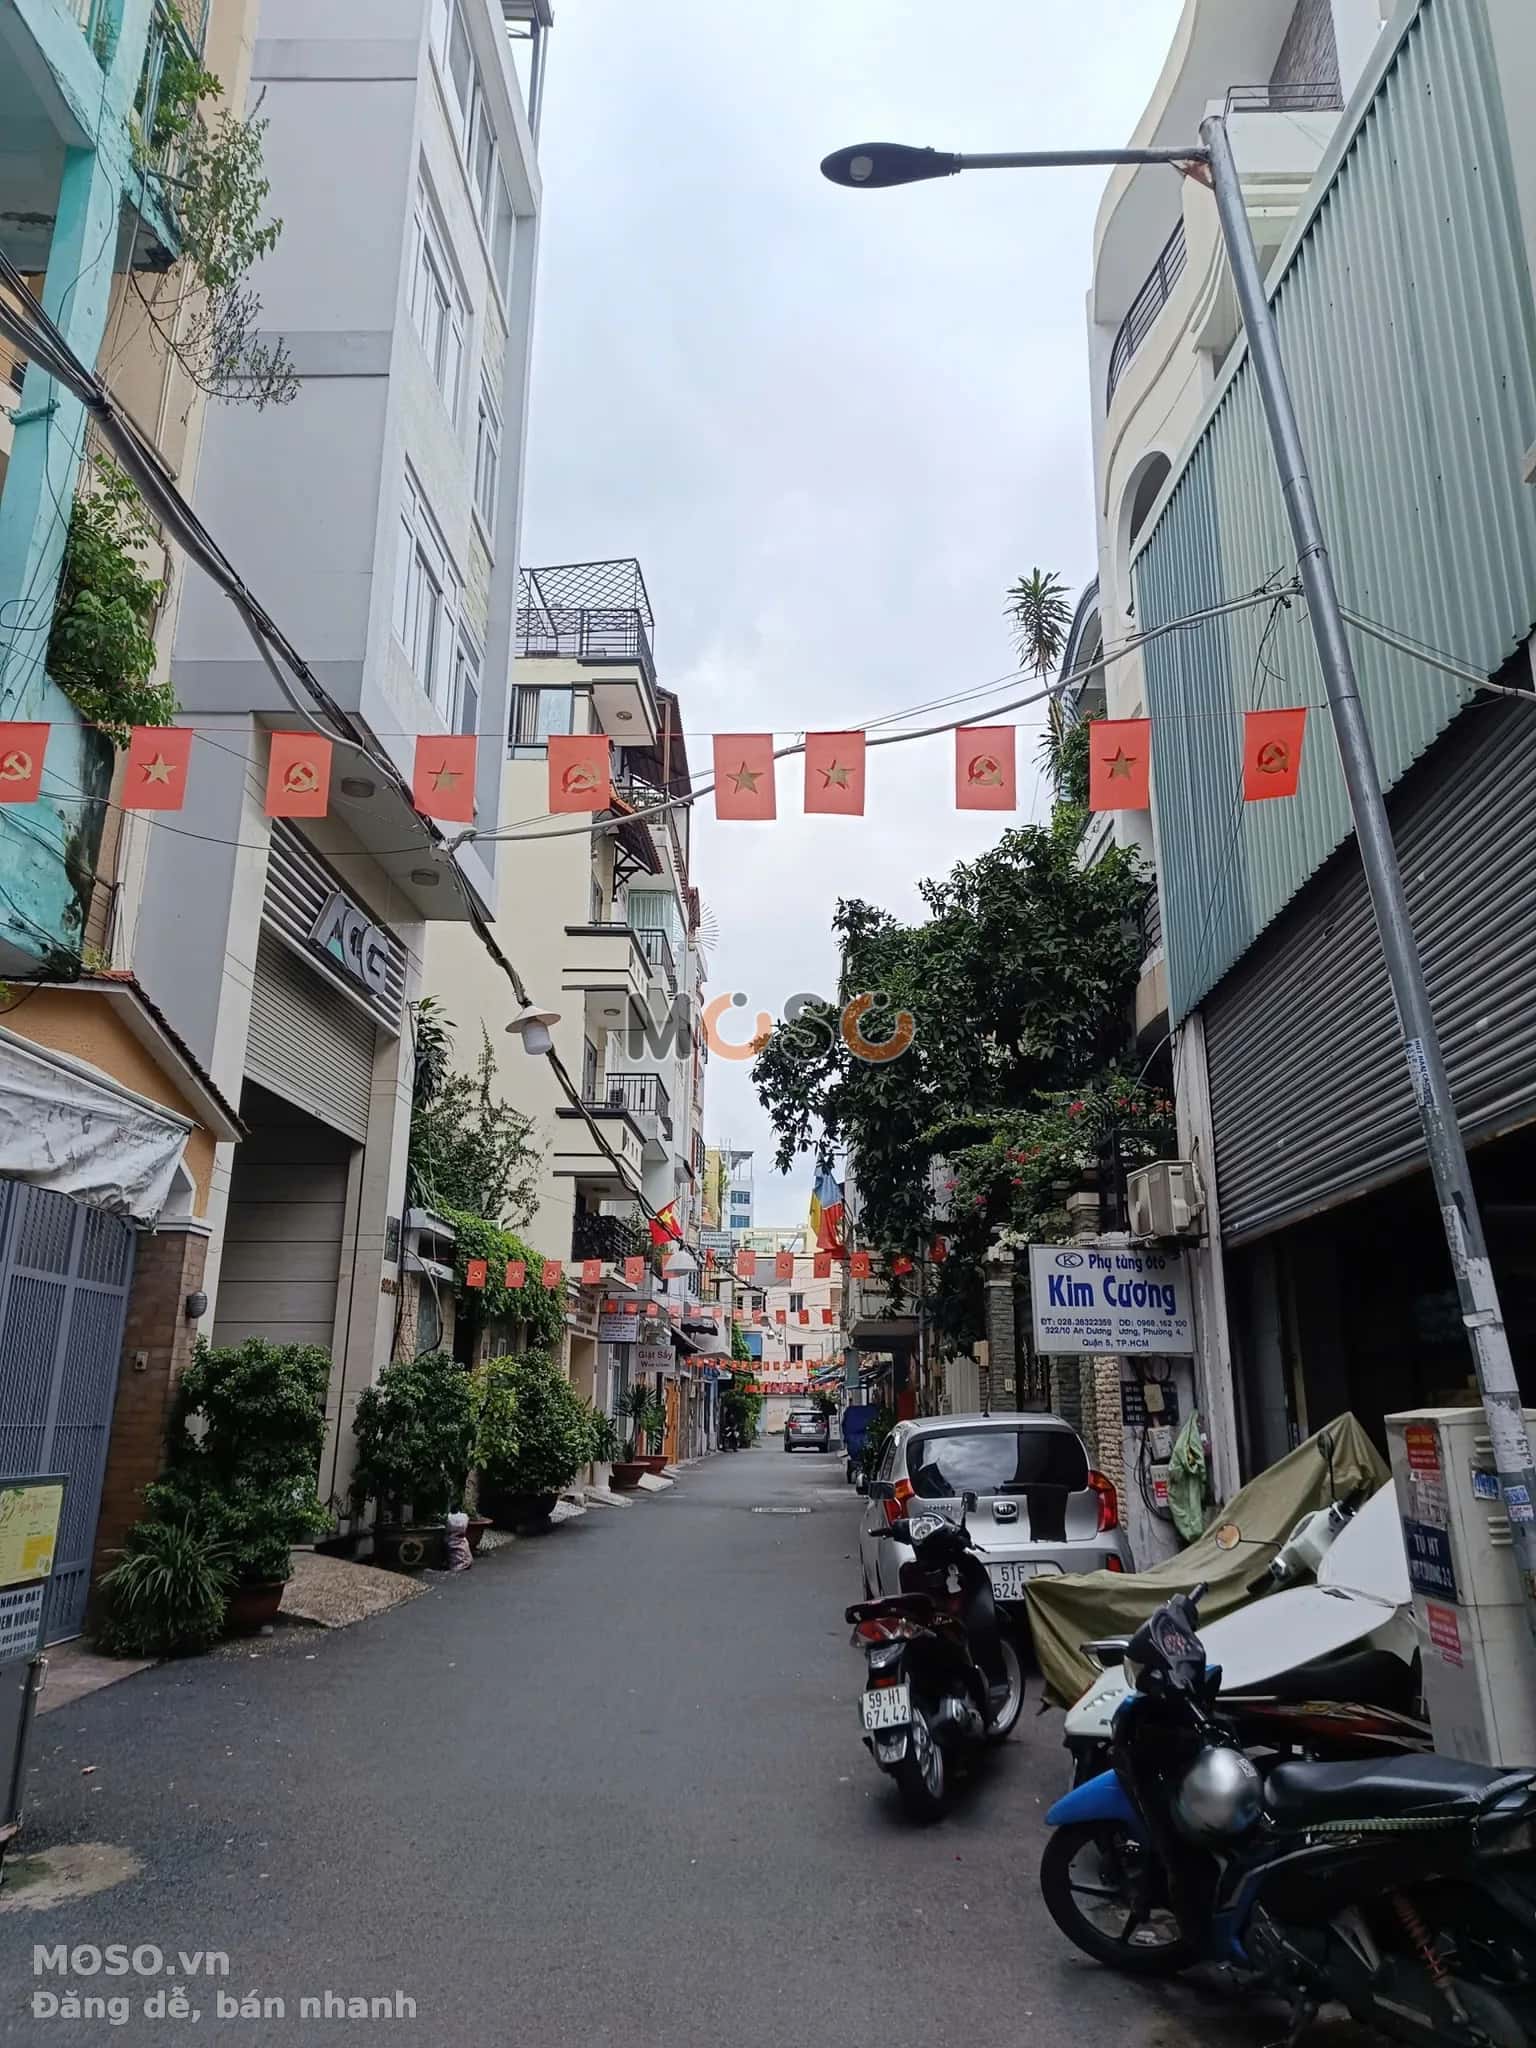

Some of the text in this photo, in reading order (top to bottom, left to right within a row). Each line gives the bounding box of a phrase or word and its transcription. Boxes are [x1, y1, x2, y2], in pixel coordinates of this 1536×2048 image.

[1089, 1254, 1112, 1272] Phụ
[1116, 1254, 1143, 1273] tùng
[1048, 1274, 1177, 1316] Kim Cương
[1073, 1327, 1085, 1335] An
[1115, 1339, 1150, 1348] TP.HCM
[1001, 1566, 1025, 1582] 51F
[868, 1688, 900, 1710] 59-H1
